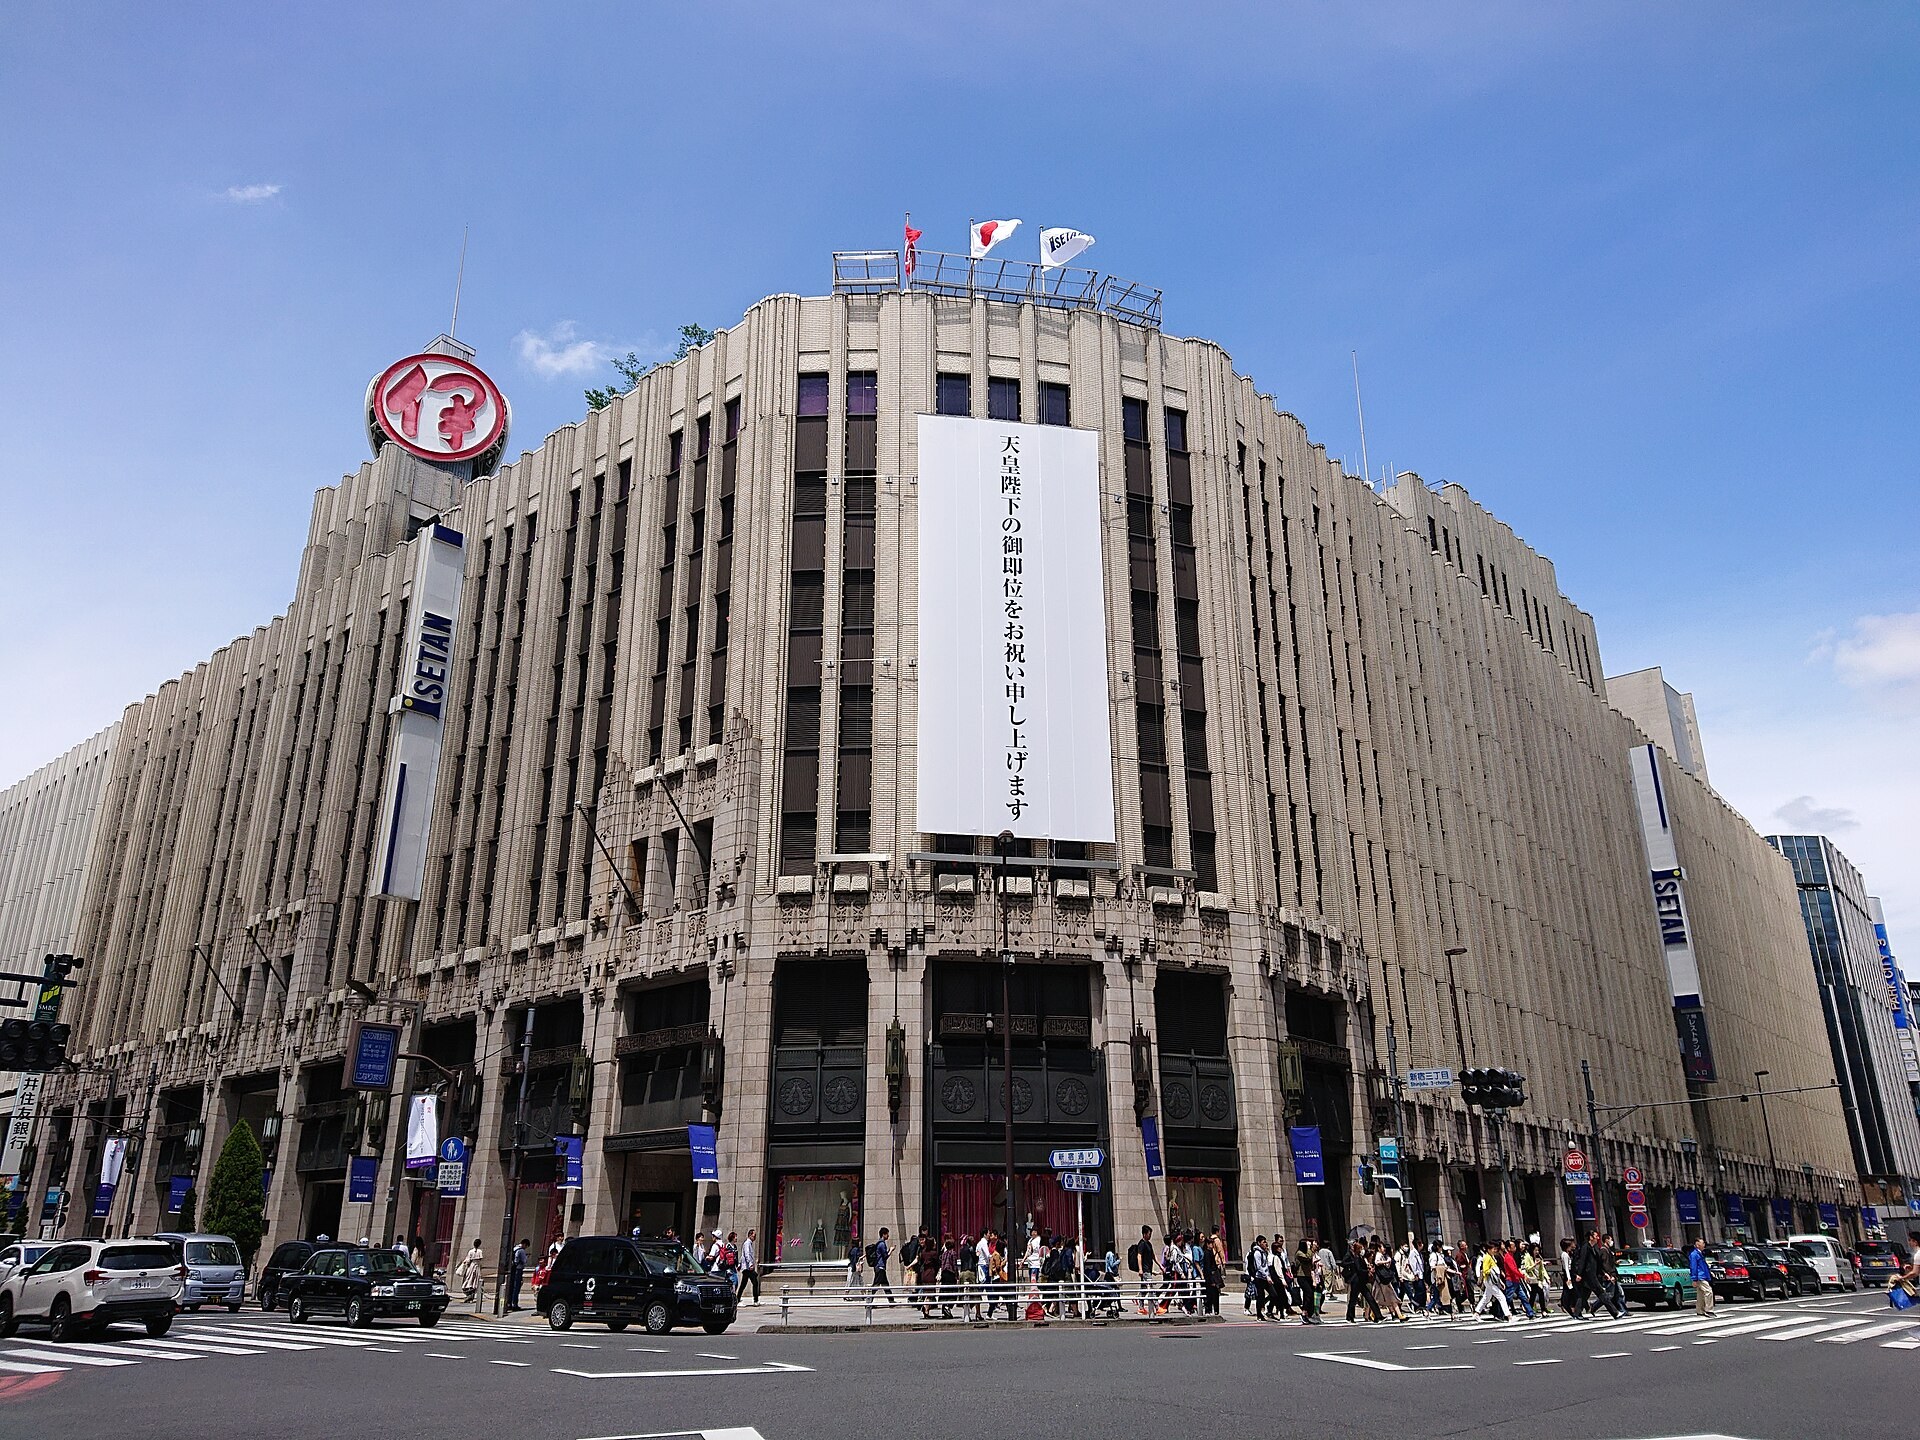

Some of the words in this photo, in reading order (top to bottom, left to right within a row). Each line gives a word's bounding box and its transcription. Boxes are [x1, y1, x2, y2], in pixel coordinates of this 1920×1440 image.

[1000, 434, 1029, 822] 天皇陛下の御即位をお祝い申し上げます
[402, 610, 453, 721] ISETAN
[1651, 866, 1687, 945] ISETAN
[1880, 955, 1893, 978] CITY
[1409, 1071, 1449, 1080] 新宿三丁目
[1058, 1151, 1093, 1160] 新宿通り
